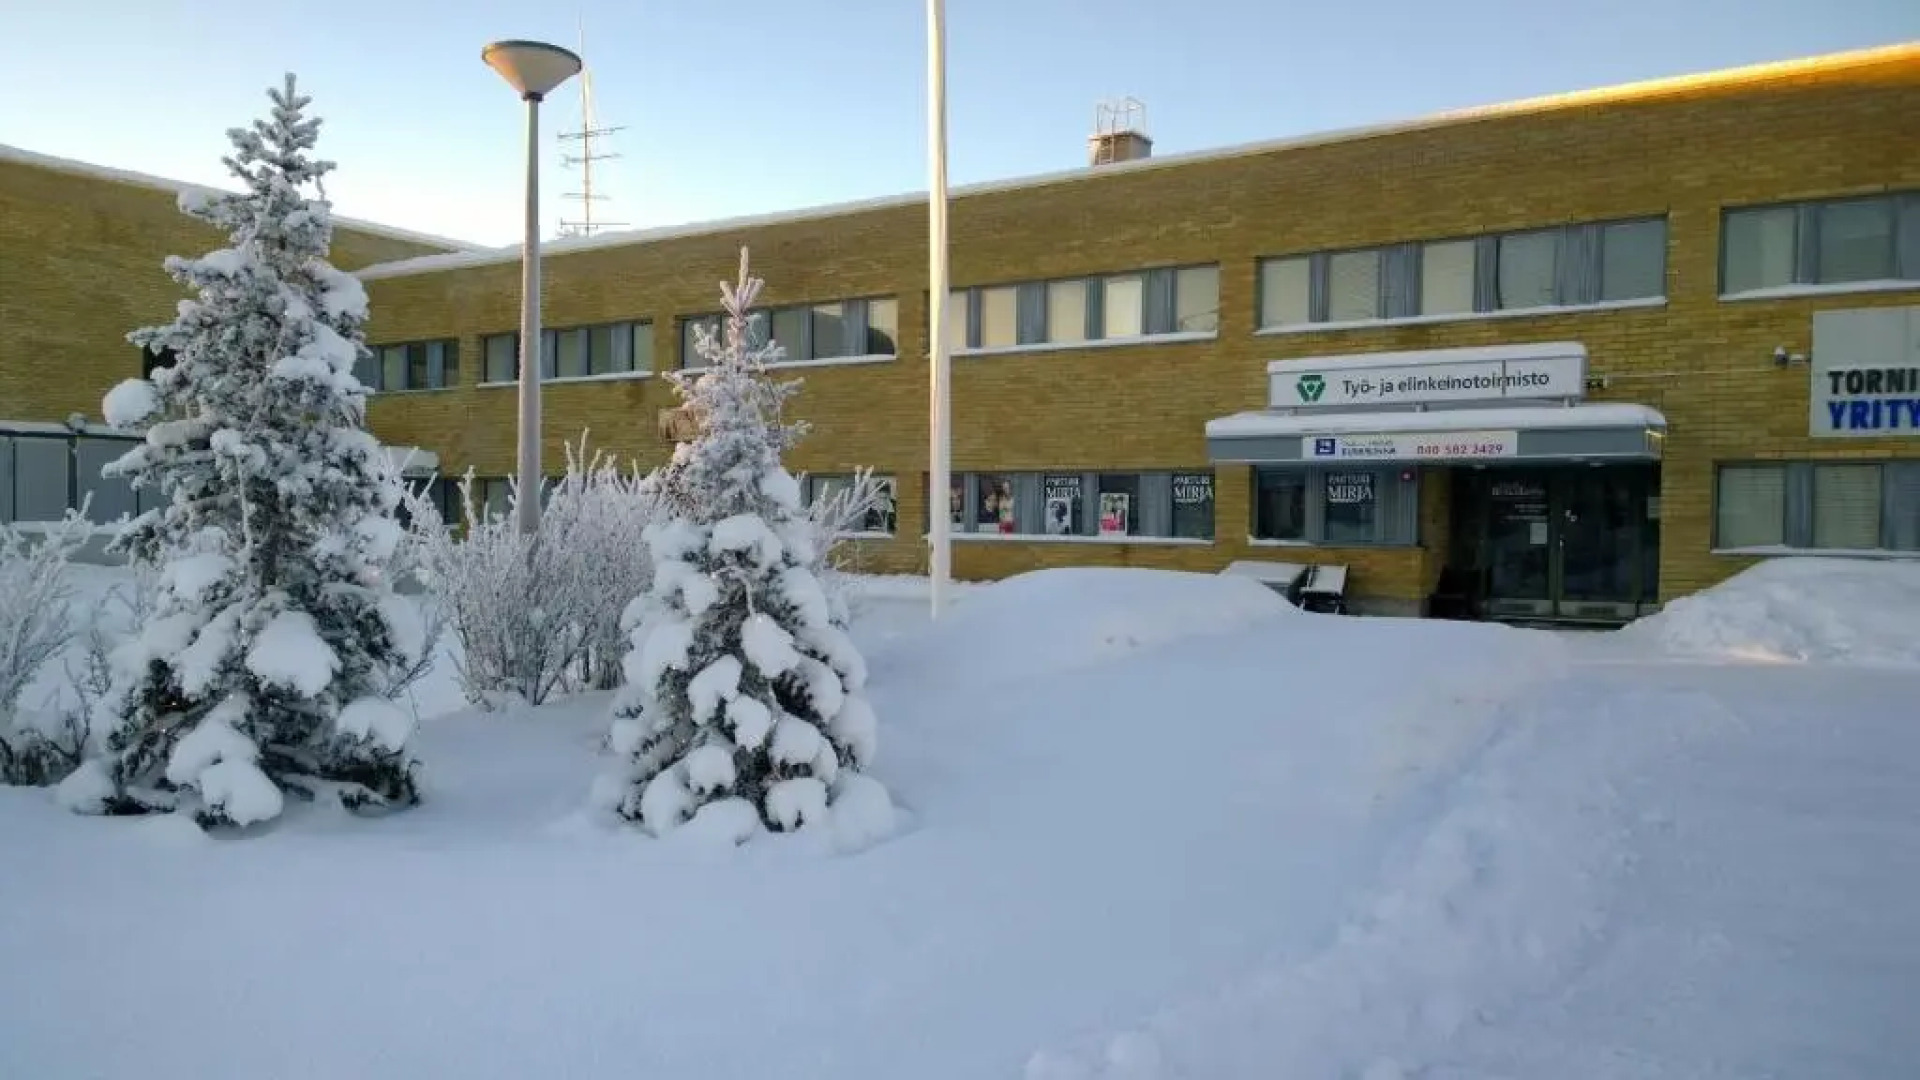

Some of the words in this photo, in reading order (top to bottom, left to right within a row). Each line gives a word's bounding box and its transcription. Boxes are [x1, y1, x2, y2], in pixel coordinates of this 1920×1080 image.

[1342, 378, 1377, 398] Työ-
[1379, 378, 1394, 397] ja
[1398, 370, 1550, 393] elinkeinotoimisto
[1827, 368, 1918, 395] TORNI
[1328, 485, 1373, 501] MIRJA
